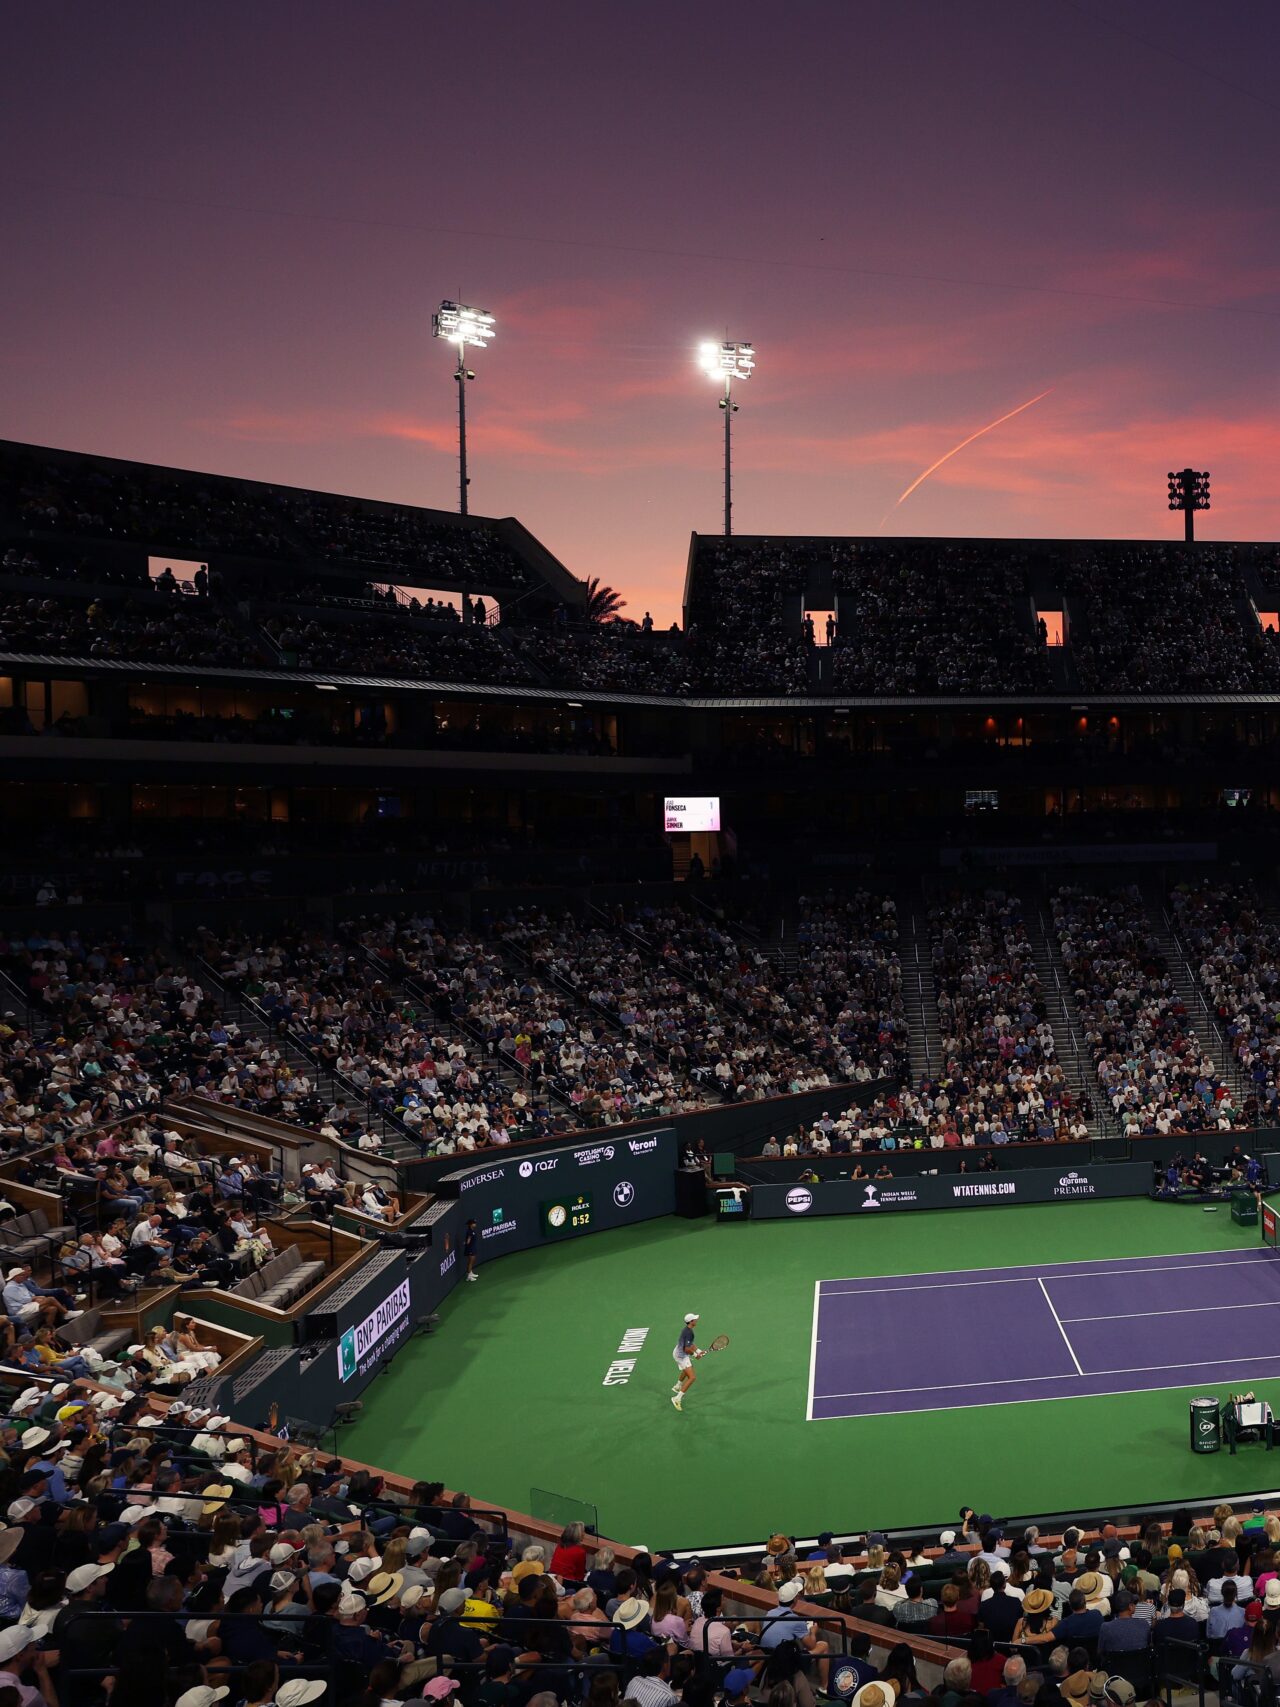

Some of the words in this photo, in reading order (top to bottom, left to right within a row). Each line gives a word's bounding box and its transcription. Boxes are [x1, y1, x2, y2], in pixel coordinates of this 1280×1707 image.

[416, 862, 489, 879] NETJETS
[628, 1137, 657, 1152] Veroni
[574, 1147, 604, 1158] SPOTLIGHT
[579, 1154, 600, 1162] CASINO
[535, 1159, 559, 1172] razr
[462, 1169, 505, 1190] SILVERSEA
[1059, 1177, 1088, 1186] Corona
[953, 1182, 1016, 1197] WTATENNIS.COM
[1054, 1185, 1095, 1195] PREMIER
[572, 1202, 590, 1212] ROLEX
[572, 1214, 590, 1226] 0:52
[482, 1226, 493, 1236] BNP
[493, 1220, 517, 1232] PARIBAS
[440, 1250, 456, 1277] ROLEX
[357, 1319, 374, 1355] BNP
[377, 1282, 408, 1335] PARIBAS
[617, 1327, 650, 1353] INDIAN
[602, 1358, 637, 1385] WELLS
